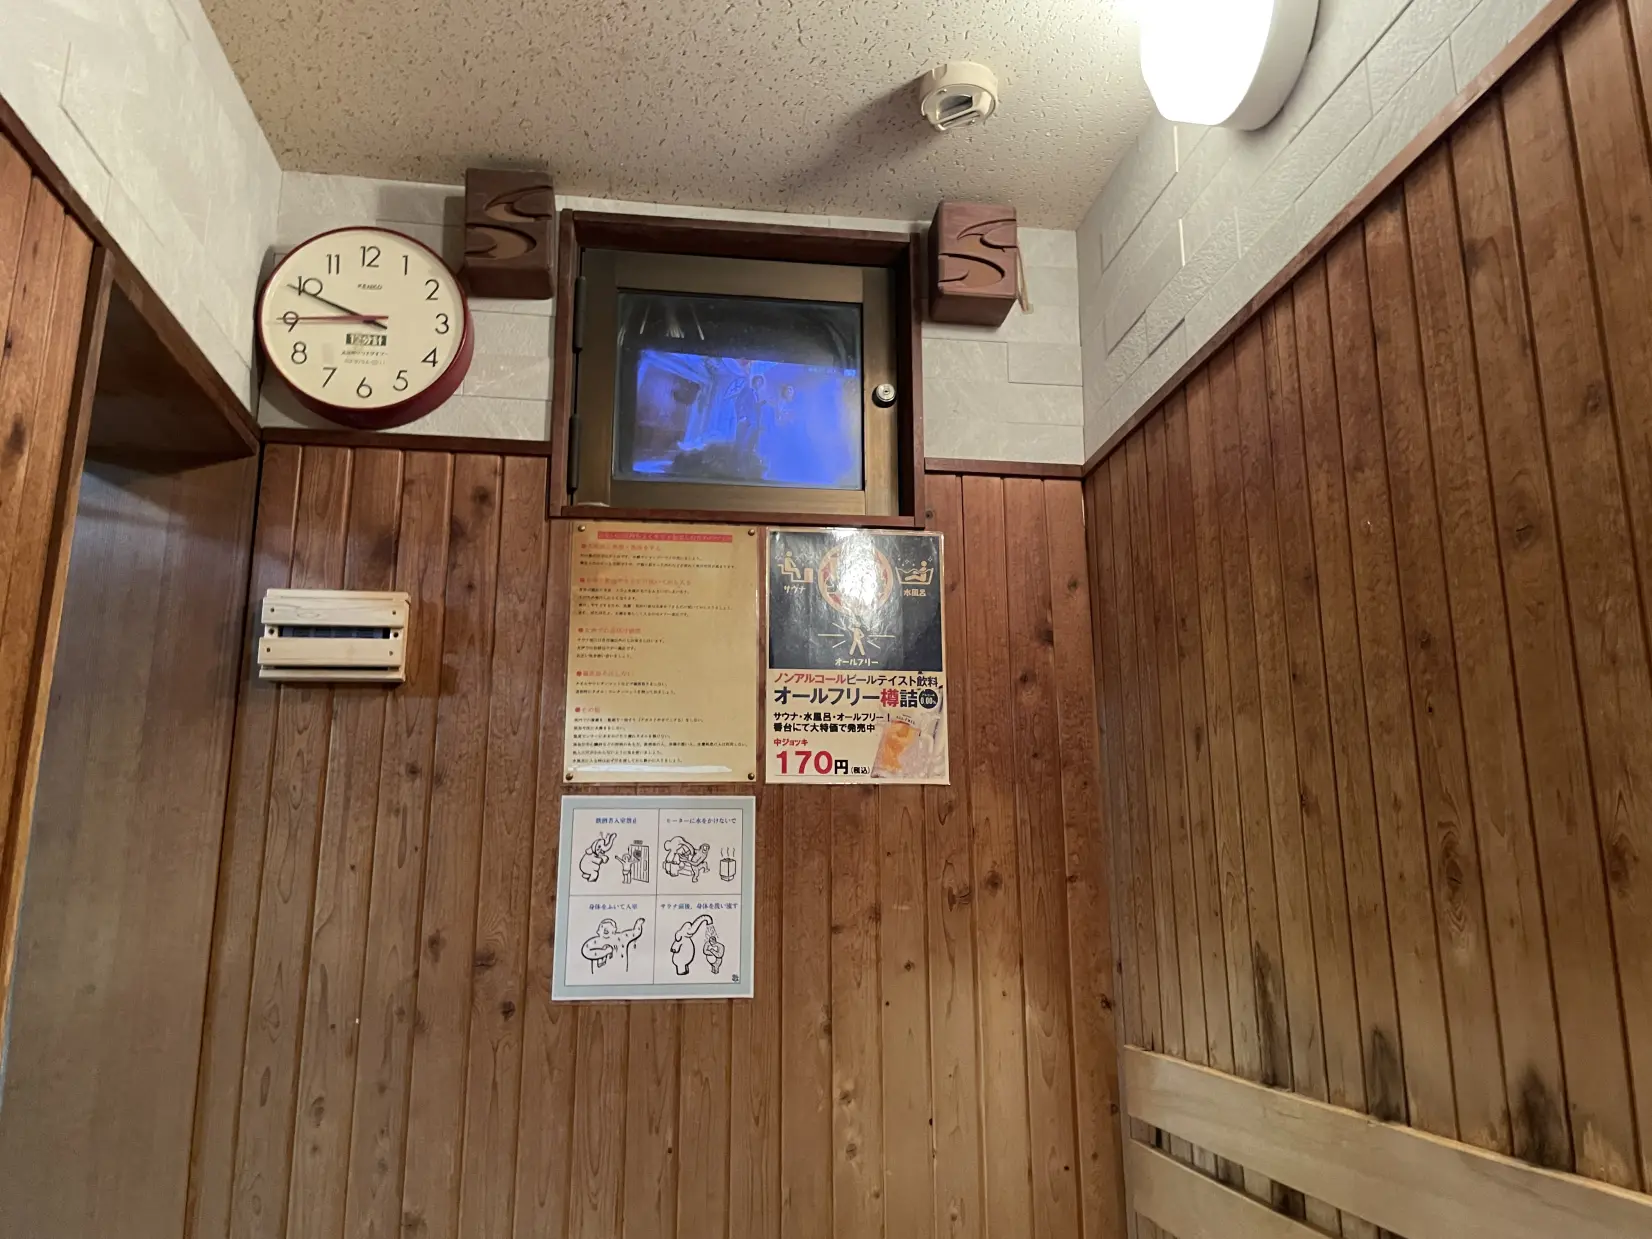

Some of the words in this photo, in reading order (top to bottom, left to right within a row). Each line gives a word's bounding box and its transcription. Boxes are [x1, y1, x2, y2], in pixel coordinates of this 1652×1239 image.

[326, 254, 340, 275] 11
[360, 246, 381, 268] 12
[402, 255, 408, 276] 1
[297, 275, 323, 296] 10
[425, 279, 439, 301] 2
[283, 311, 299, 333] 9
[435, 313, 449, 334] 3
[291, 341, 307, 364] 8
[421, 347, 438, 368] 4
[322, 367, 337, 388] 7
[356, 377, 372, 399] 6
[393, 370, 409, 391] 5
[783, 585, 806, 594] サウナ
[903, 588, 927, 597] 水風呂
[834, 657, 879, 667] オールフリー
[773, 673, 938, 688] ノンアルコールビールテイスト飲料
[773, 686, 918, 708] オールフリー樽詰
[773, 722, 876, 733] 番台にて大特価で発売中
[773, 737, 809, 747] 中ジョッキ
[666, 816, 737, 825] ヒーターに水をかけないで
